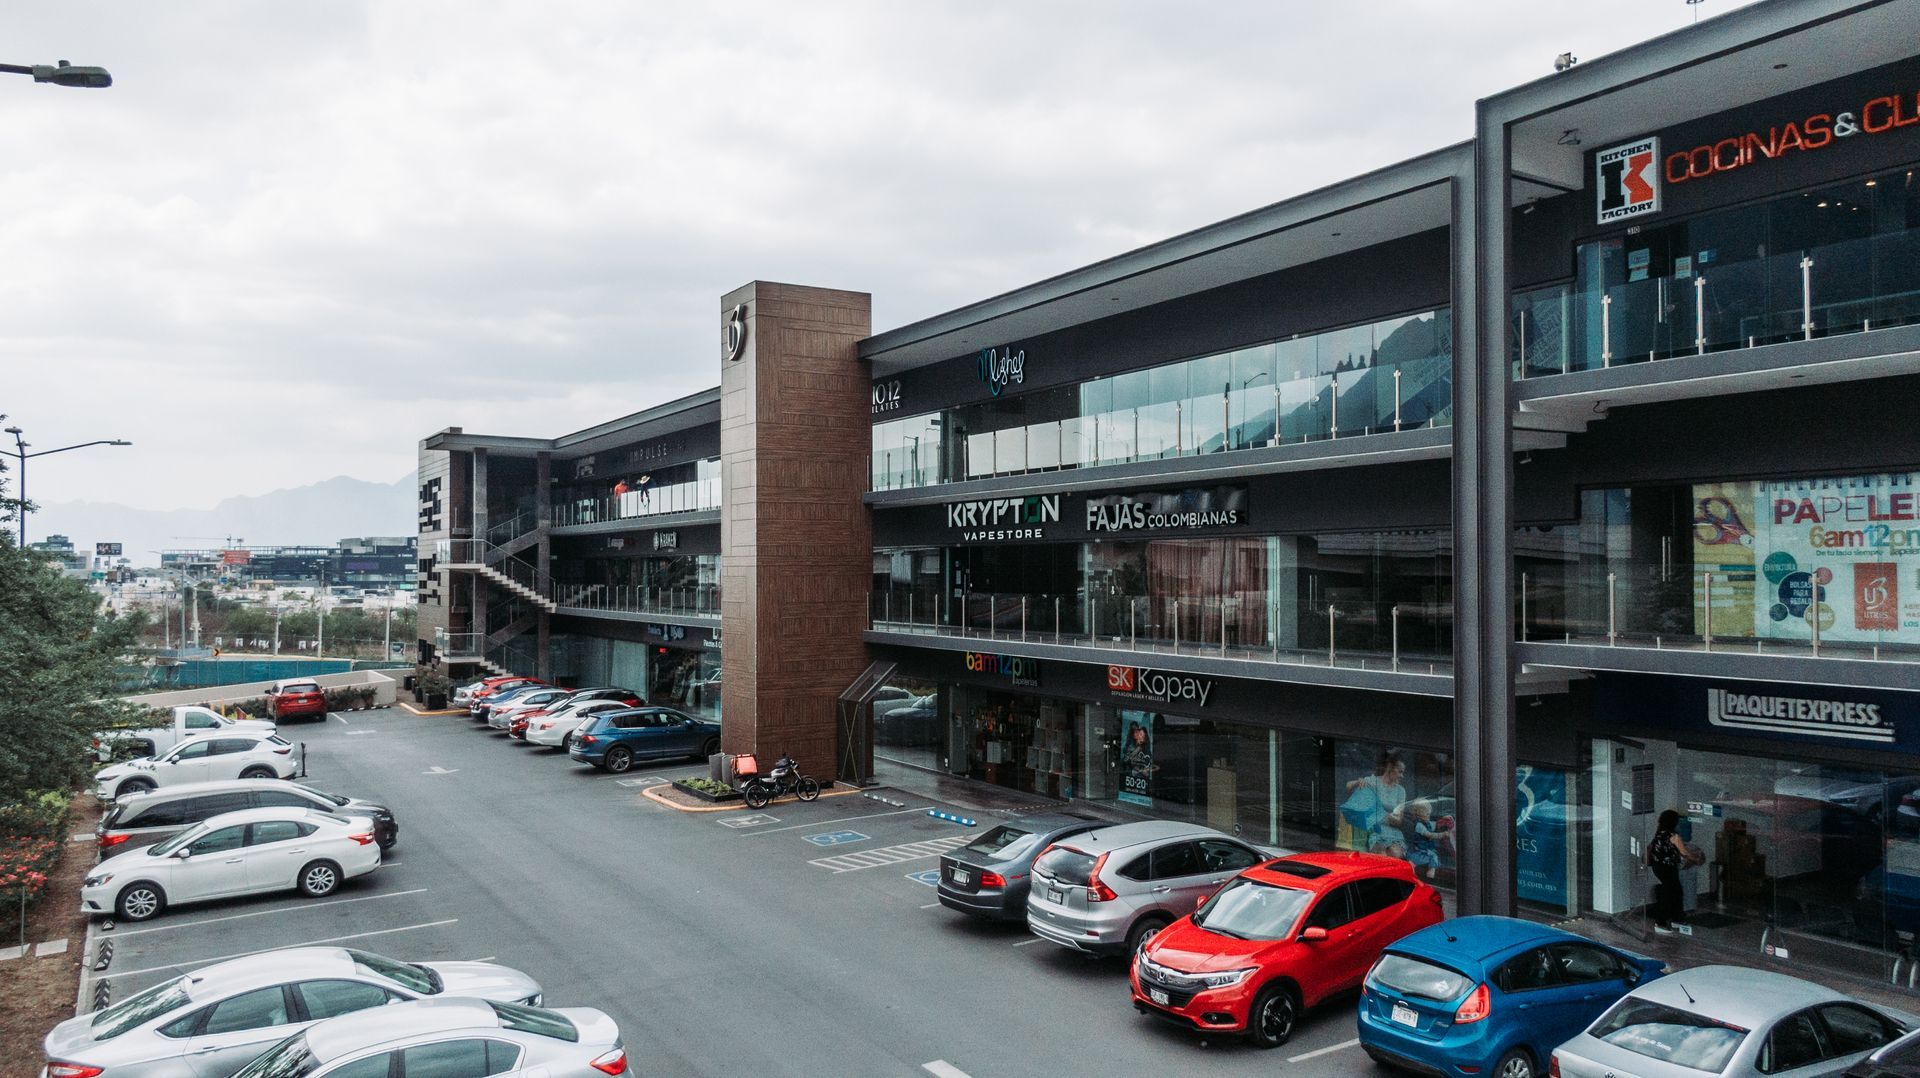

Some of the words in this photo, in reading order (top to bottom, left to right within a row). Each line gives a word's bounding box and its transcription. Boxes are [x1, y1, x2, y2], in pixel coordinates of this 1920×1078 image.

[1601, 143, 1652, 163] KITCHEN
[1602, 201, 1653, 220] FACTORY
[948, 495, 1060, 528] KRYPTON
[1087, 502, 1146, 532] FAJAS
[1147, 510, 1238, 528] COLOMBIANAS
[1774, 493, 1920, 525] PAPELE
[963, 529, 1043, 541] VAPESTORE
[1108, 666, 1132, 688] SK
[1137, 667, 1212, 707] Kopay
[1726, 693, 1881, 726] PAQUETEXPRESS
